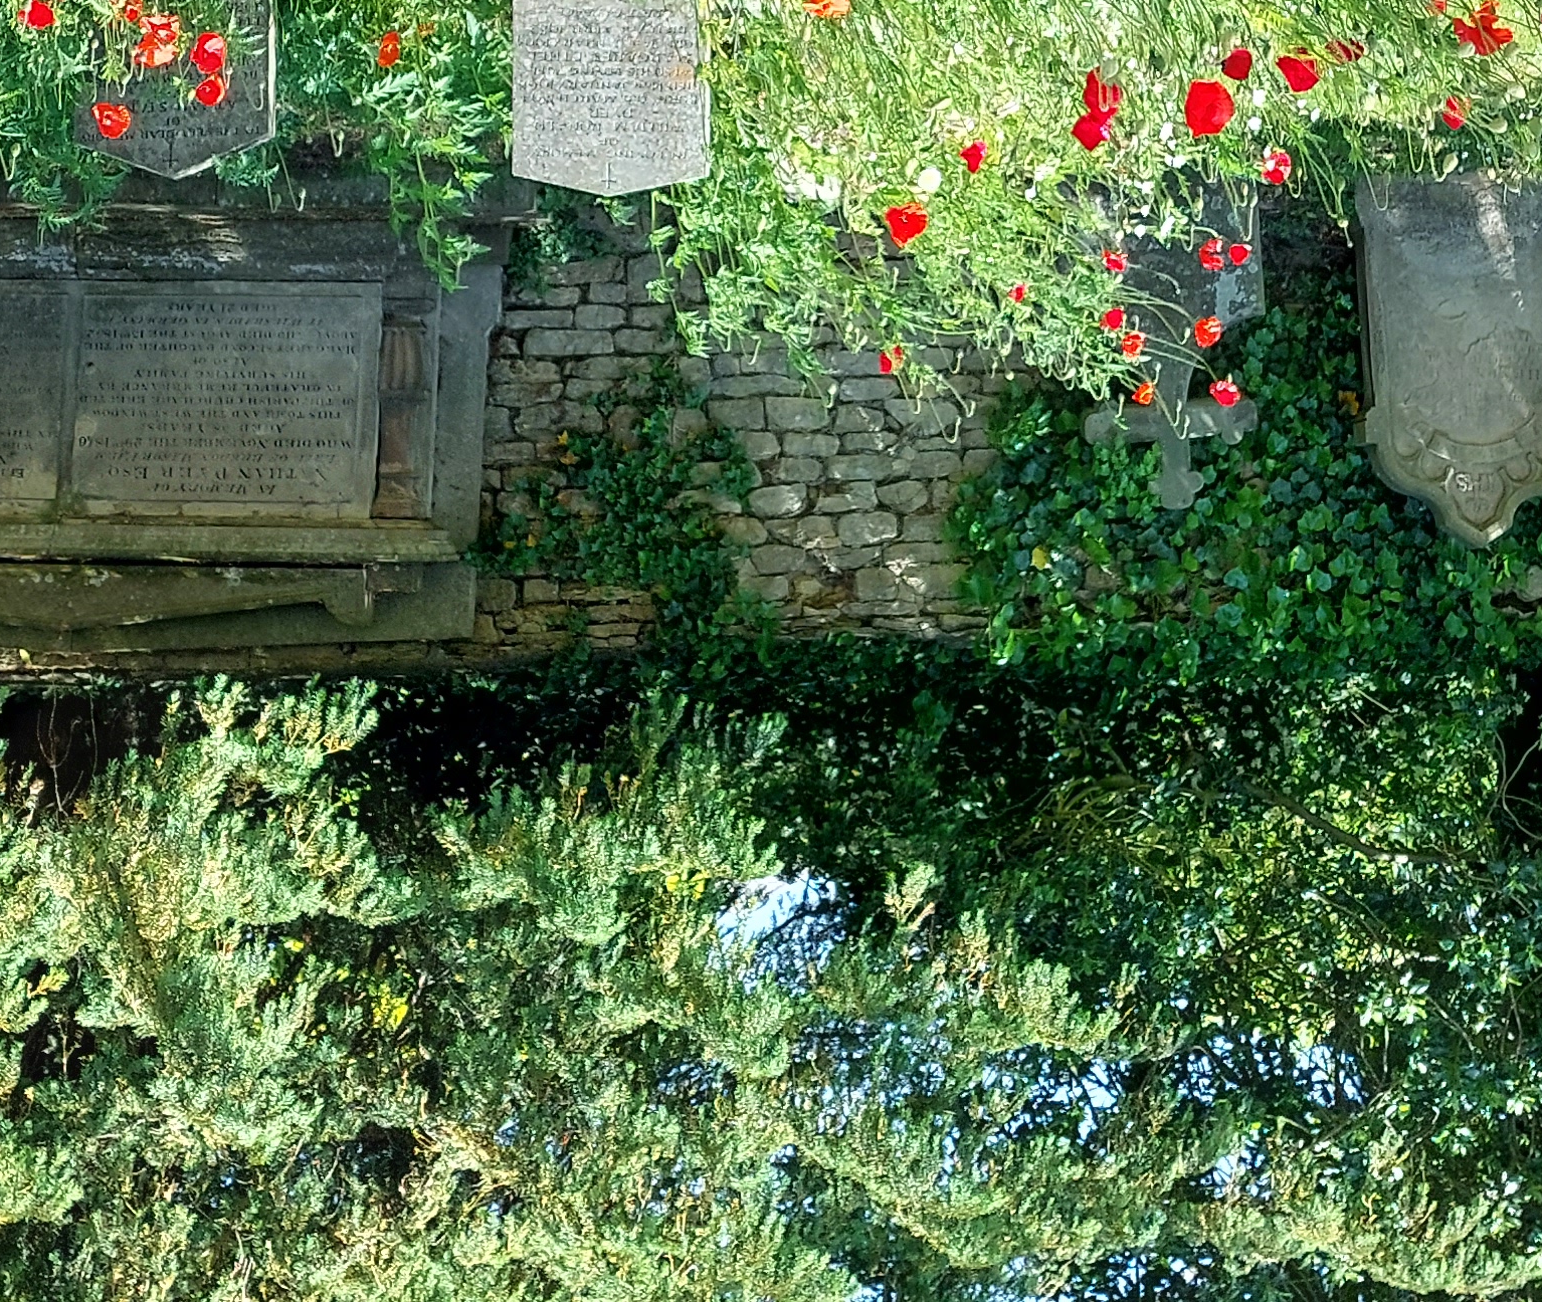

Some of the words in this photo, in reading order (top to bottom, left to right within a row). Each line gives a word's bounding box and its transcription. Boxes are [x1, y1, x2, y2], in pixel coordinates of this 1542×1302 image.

[557, 79, 627, 91] JANUARY
[587, 106, 634, 119] DYER
[163, 116, 181, 127] OF
[597, 137, 619, 146] OF
[237, 329, 273, 339] DIED
[137, 342, 216, 352] DAUGHTER
[275, 344, 357, 355] MARGARET
[132, 368, 189, 379] FAMILY
[193, 369, 277, 380] SURVIVING
[120, 381, 237, 393] REMEMBRANCE
[241, 382, 321, 393] GRATEFUL
[231, 408, 259, 418] AND
[307, 409, 341, 419] THIS
[239, 423, 287, 434] AGED
[148, 437, 178, 448] THE
[181, 437, 269, 449] NOVEMBER
[273, 438, 312, 449] DIED
[315, 439, 352, 450] WHO
[236, 465, 328, 482] NATHAN
[147, 483, 172, 493] OF
[174, 483, 251, 495] MEMORY
[256, 484, 277, 495] IN
